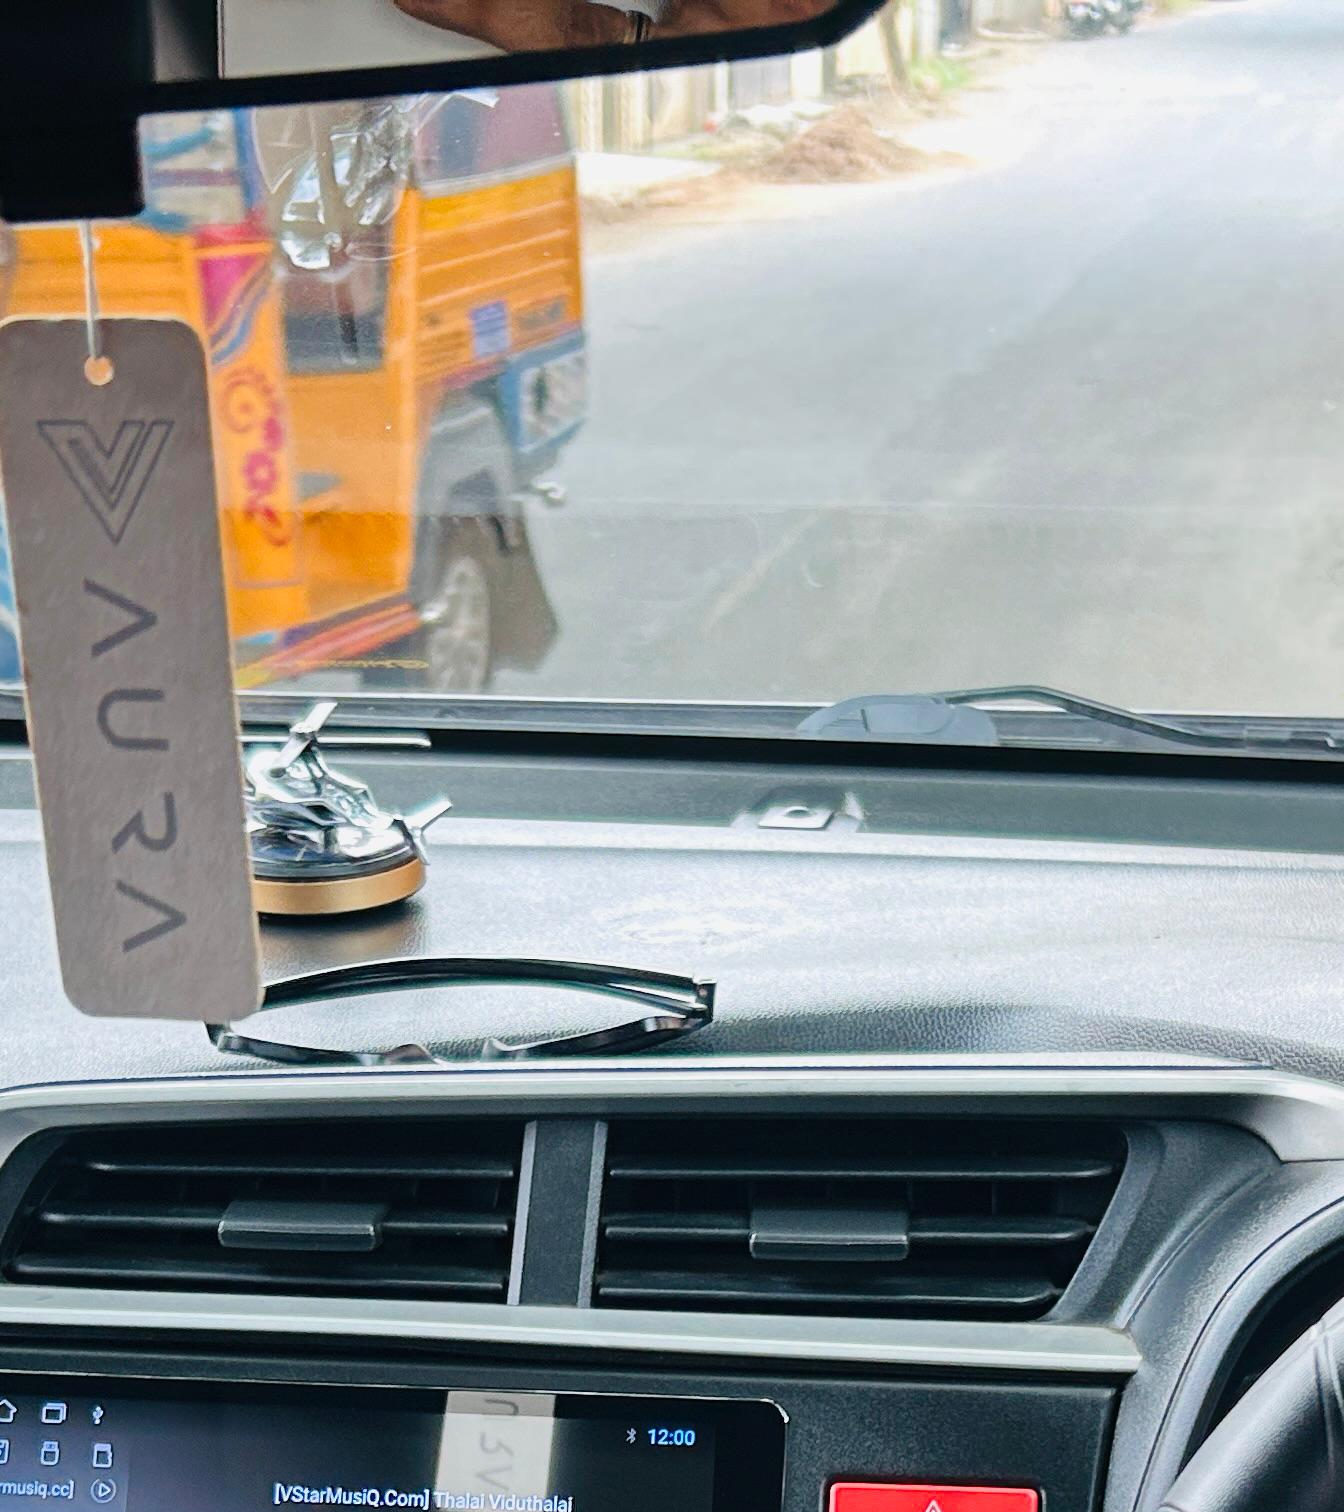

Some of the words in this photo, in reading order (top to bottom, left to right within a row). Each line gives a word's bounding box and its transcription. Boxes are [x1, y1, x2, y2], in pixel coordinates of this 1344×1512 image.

[648, 1428, 696, 1446] 12:00
[274, 1483, 430, 1511] [VStarMusiQ.Com]
[435, 1491, 485, 1511] Thalai
[489, 1494, 573, 1512] Viduthalai
